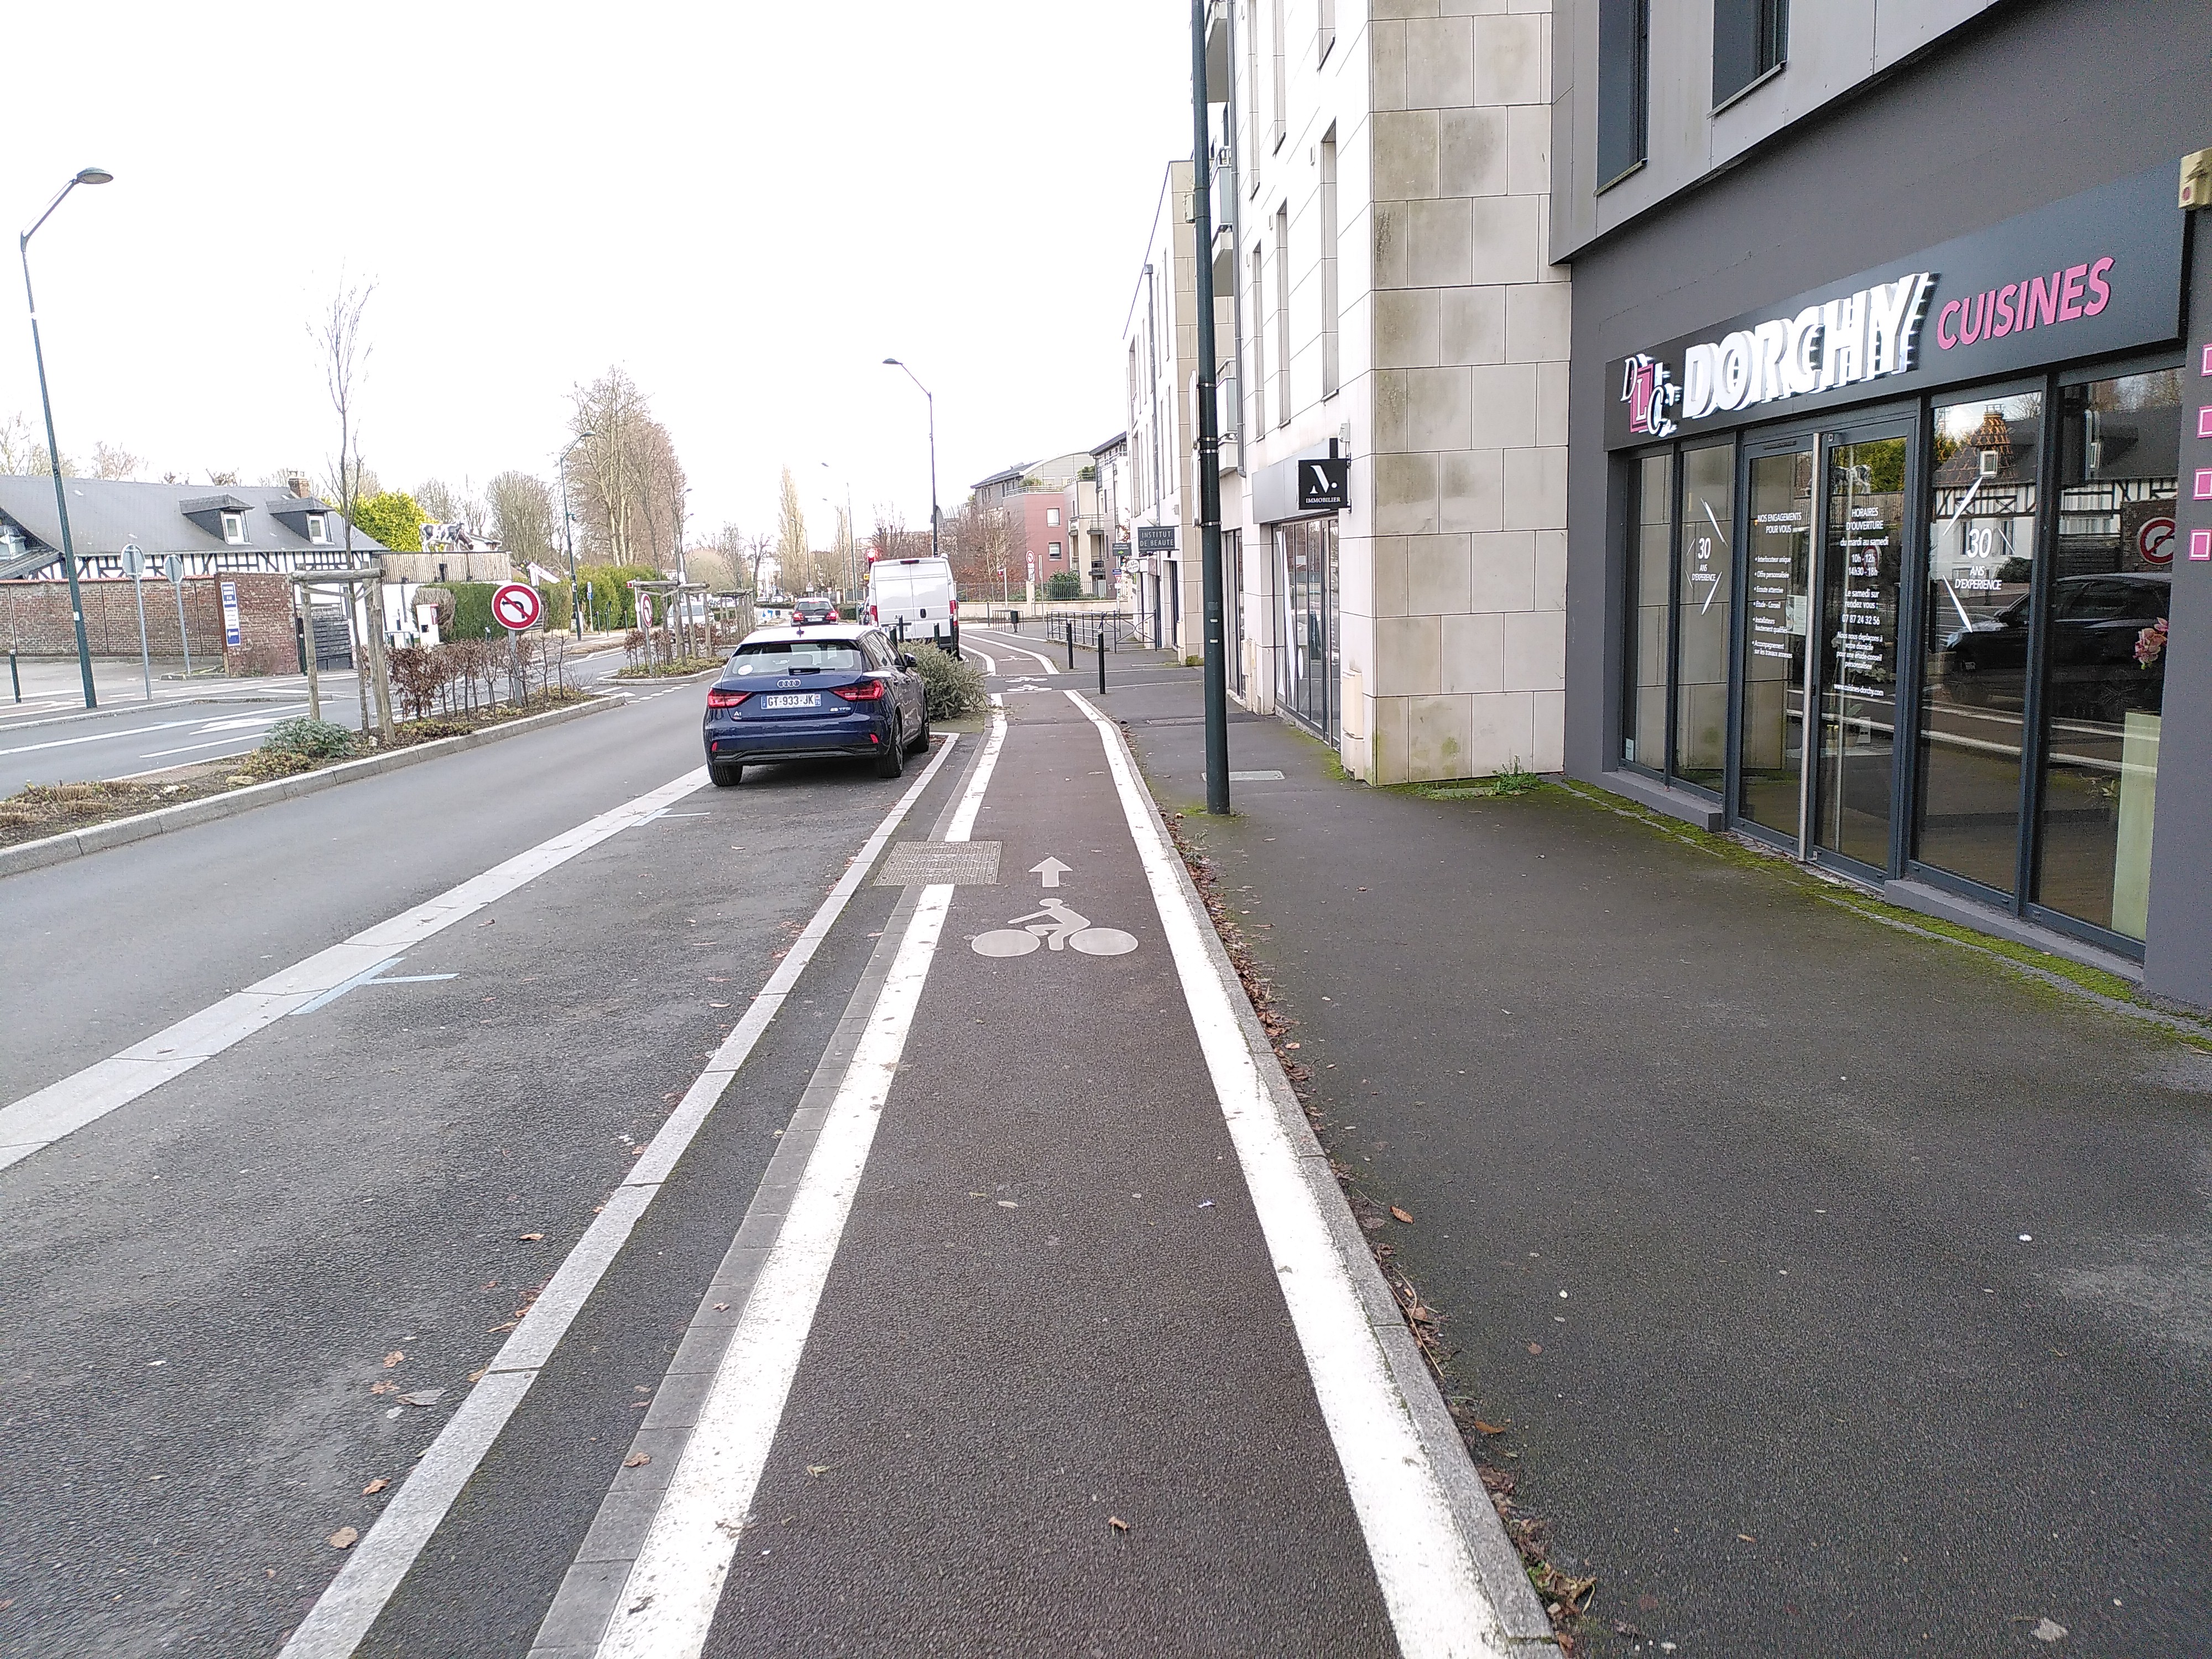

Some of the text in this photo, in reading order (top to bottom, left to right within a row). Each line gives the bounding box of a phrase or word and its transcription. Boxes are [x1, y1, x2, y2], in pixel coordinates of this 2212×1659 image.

[1682, 255, 2116, 420] DORCHY CUISINES
[1851, 507, 1879, 517] HORAIRES
[1757, 512, 1802, 523] NOS ENGAGEMENTS
[1766, 525, 1792, 534] POUR VOUS
[1846, 520, 1884, 531] D'OUVERTURE
[1840, 538, 1847, 546] du
[1848, 537, 1863, 546] mardi
[1870, 536, 1889, 546] samedi
[1966, 528, 1992, 559] 30
[1698, 538, 1711, 559] 30
[1851, 554, 1861, 563] 10h
[1865, 554, 1875, 563] 12h
[1848, 566, 1864, 576] 14h30
[1868, 567, 1878, 576] 18h
[1970, 566, 1985, 576] ANS
[1955, 578, 2002, 590] D'EXPERIENCE
[1845, 588, 1851, 597] Le
[1852, 588, 1870, 598] samedi
[1845, 598, 1862, 608] rendez
[1842, 614, 1880, 625] 07 87 24 32 56
[1856, 642, 1874, 651] domicile
[1834, 684, 1884, 697] www.cuisines-dorchy.com
[768, 695, 813, 707] GT-933-JK
